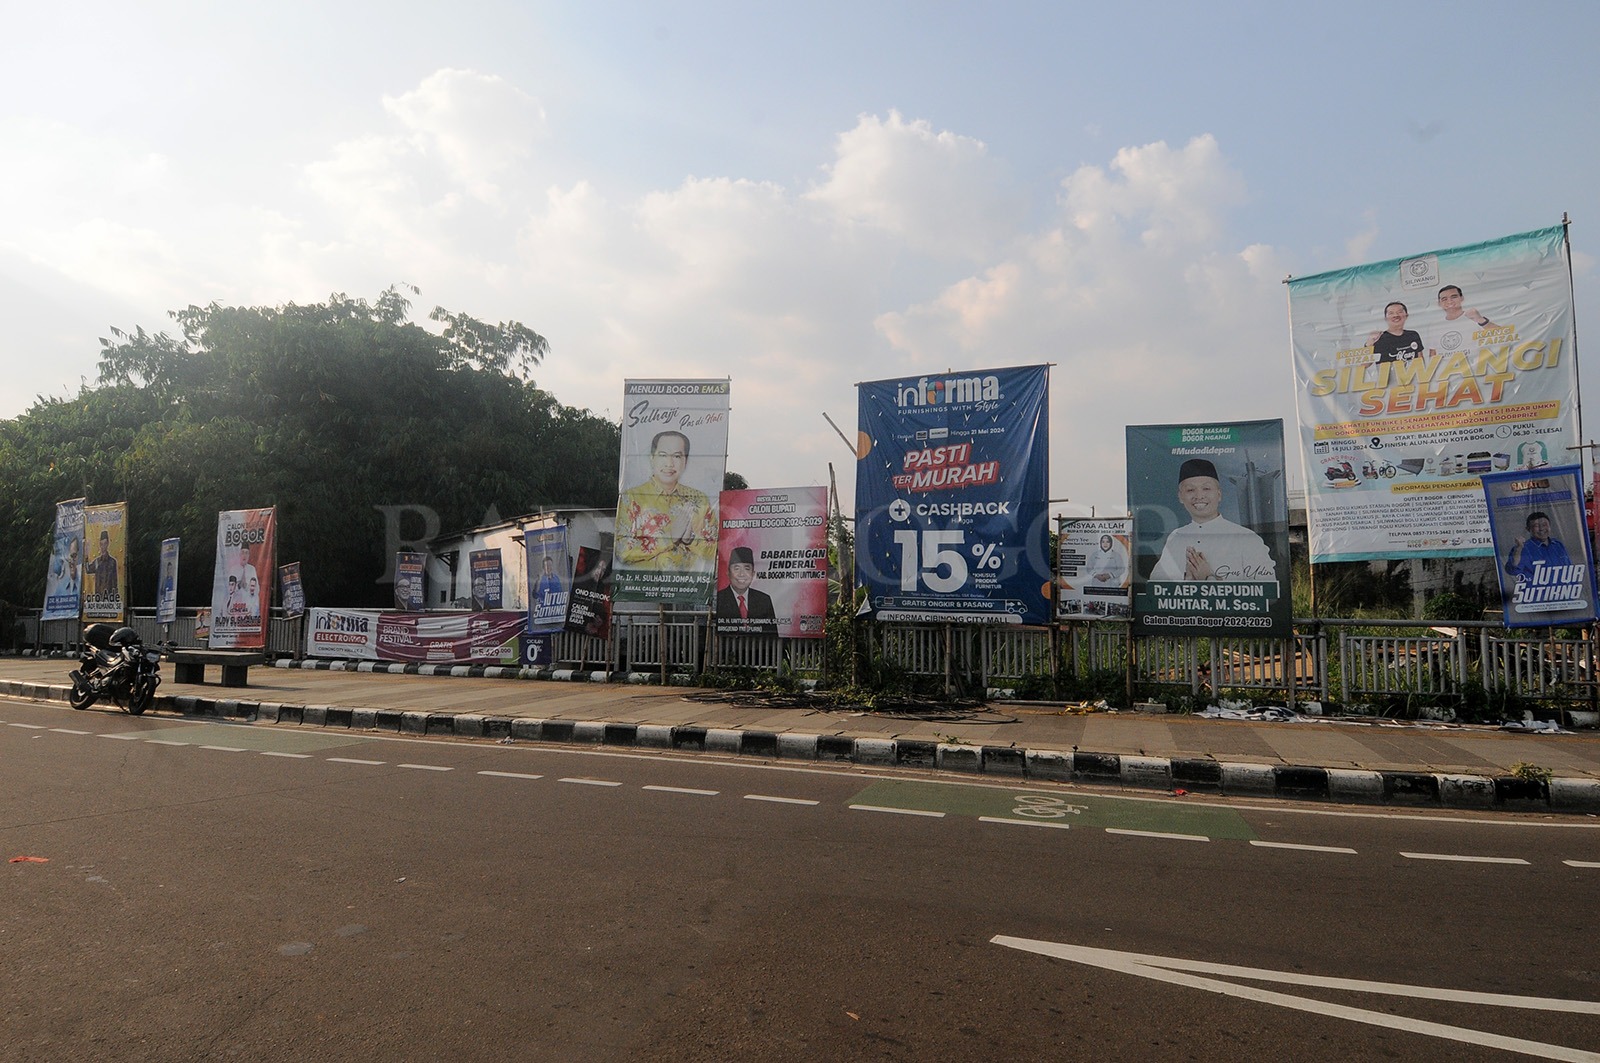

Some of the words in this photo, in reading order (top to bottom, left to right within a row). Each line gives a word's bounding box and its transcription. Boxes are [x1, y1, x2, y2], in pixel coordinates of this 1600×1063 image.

[1405, 276, 1436, 286] SILIWANGI
[1474, 326, 1510, 339] KANG
[1478, 333, 1520, 346] FAIZAL
[1338, 347, 1370, 359] KANG
[1344, 354, 1376, 365] RIZAL
[1311, 337, 1562, 396] SILIWANGI
[629, 386, 664, 394] MENUJU
[666, 386, 700, 394] BOGOR
[701, 385, 725, 394] EMAS
[898, 375, 1000, 408] informa
[1359, 372, 1515, 416] SEHAT
[898, 406, 948, 415] FURNISHINGS
[974, 400, 1001, 413] Style
[695, 416, 704, 425] di
[1407, 421, 1450, 430] KESEHATAN
[1495, 412, 1538, 421] DOORPRIZE
[1431, 412, 1466, 421] BERSAMA
[1182, 428, 1204, 436] BOGOR
[905, 444, 968, 469] PASTI
[1171, 446, 1235, 456] #Mudadidepan
[894, 475, 912, 485] TER
[912, 463, 995, 488] MURAH
[749, 504, 770, 515] CALON
[771, 503, 796, 514] BUPATI
[916, 502, 1010, 516] CASHBACK
[227, 522, 245, 530] CALON
[723, 518, 761, 529] KABUPATEN
[761, 518, 785, 528] BOGOR
[785, 516, 823, 528] 2024-2029
[225, 528, 266, 546] BOGOR
[760, 549, 825, 560] BABARENGAN
[768, 560, 815, 571] JENDERAL
[894, 529, 968, 593] 15
[971, 543, 1001, 569] %
[615, 573, 625, 581] Dr.
[642, 575, 671, 583] SULHAJJI
[756, 571, 767, 580] KAB.
[767, 571, 785, 580] BOGOR
[786, 571, 799, 579] PASTI
[1215, 565, 1240, 579] Gus
[1243, 565, 1274, 580] Udin
[102, 588, 121, 603] Ade
[575, 588, 589, 597] ONO
[1153, 585, 1171, 596] Dr.
[1173, 585, 1198, 596] AEP
[1200, 585, 1263, 597] SAEPUDIN
[901, 599, 927, 607] GRATIS
[928, 600, 956, 608] ONGKIR
[1158, 599, 1212, 611] MUHTAR,
[1215, 599, 1230, 610] M.
[1233, 599, 1260, 610] Sos.
[887, 614, 922, 622] INFORMA
[926, 615, 964, 623] CIBINONG
[967, 615, 984, 623] CITY
[987, 616, 1010, 624] MALL
[1144, 616, 1168, 625] Calon
[1169, 616, 1196, 626] Bupati
[1197, 617, 1223, 627] Bogor
[1224, 617, 1272, 627] 2024-2029
[383, 626, 410, 635] BRAND
[316, 633, 367, 644] ELECTRONICS
[379, 634, 414, 645] FESTIVAL
